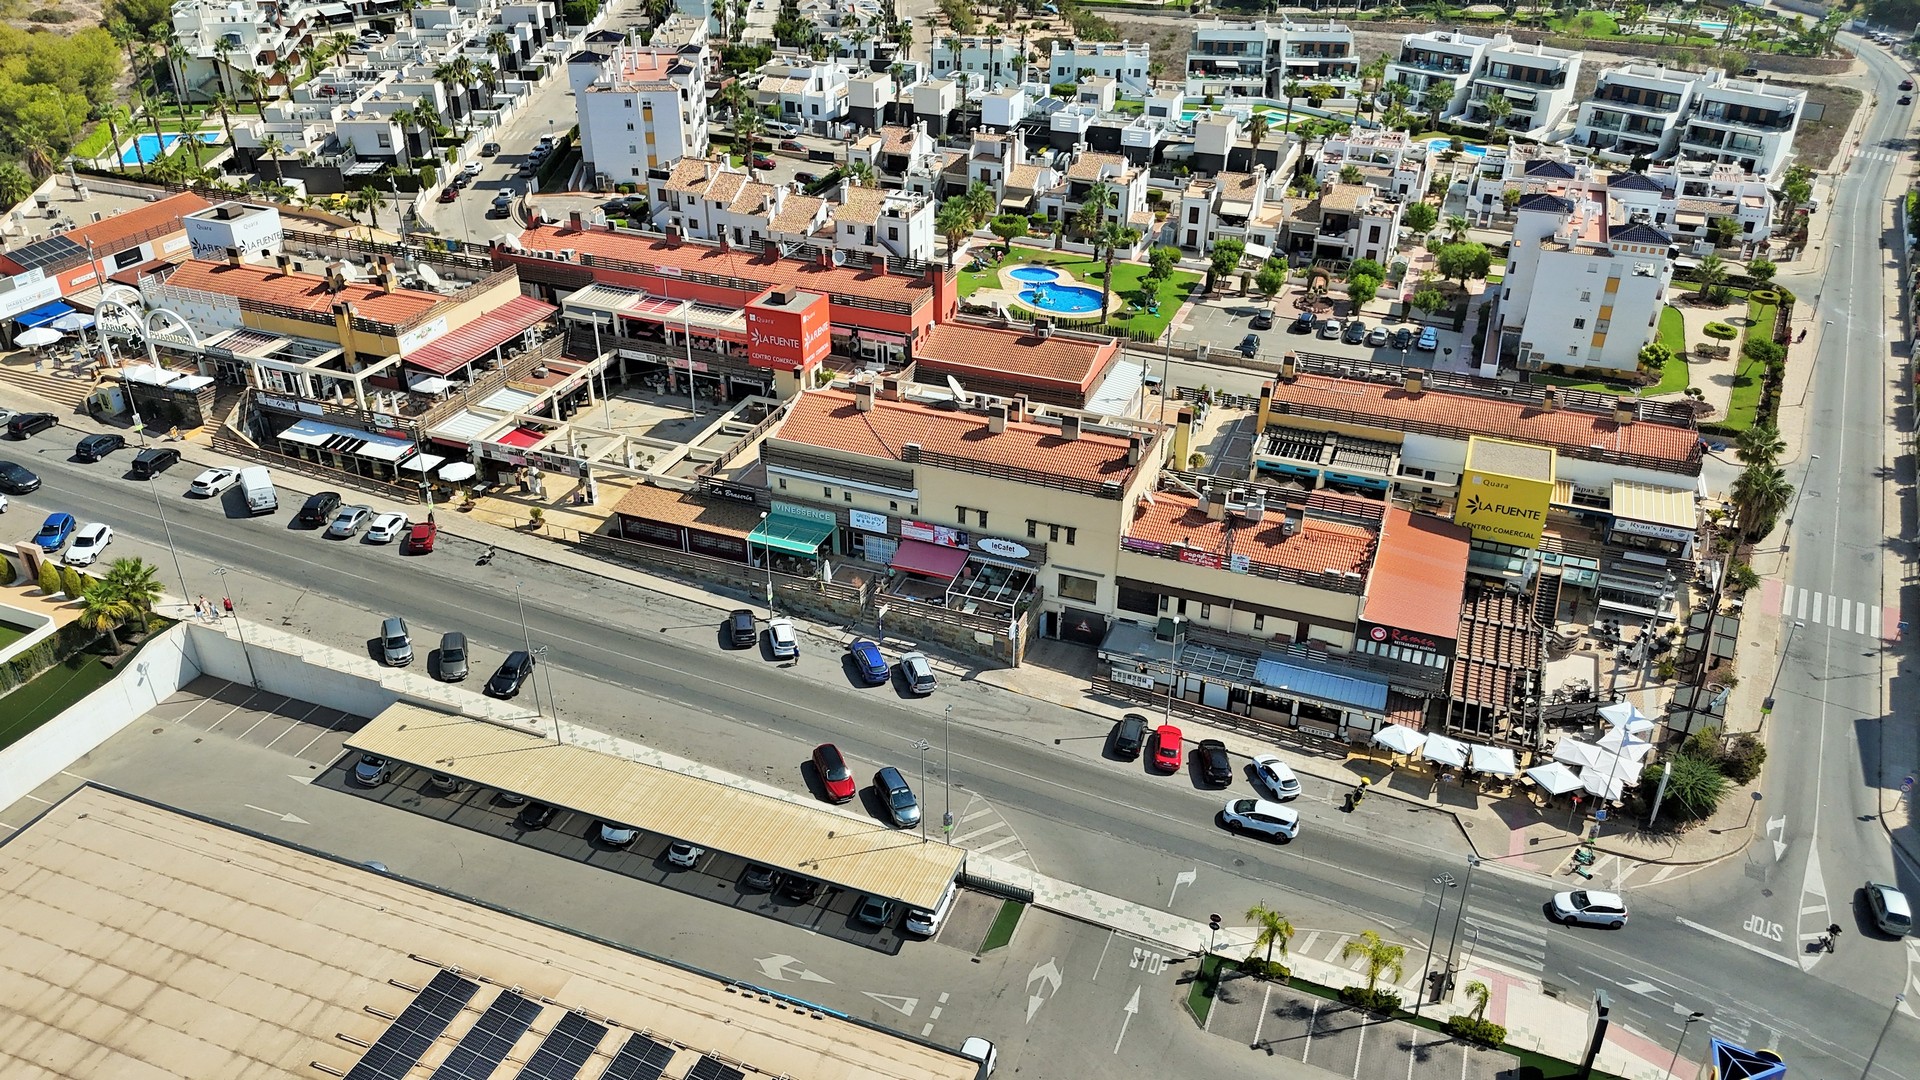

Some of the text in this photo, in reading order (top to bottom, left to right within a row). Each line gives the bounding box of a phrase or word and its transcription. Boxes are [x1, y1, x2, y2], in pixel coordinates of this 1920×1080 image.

[759, 334, 799, 349] LA FUENTE
[752, 352, 772, 361] CENTRO
[1483, 479, 1509, 489] Quara
[775, 503, 831, 521] VINESSENCE
[1478, 501, 1541, 521] LA FUENTE
[1461, 521, 1536, 540] CENTRO COMERCIAL
[991, 541, 1016, 553] leCafet
[1391, 628, 1436, 647] Ramen
[1393, 639, 1420, 649] RESTAURANTE
[1743, 914, 1784, 942] STOP
[1129, 947, 1170, 976] STOP
